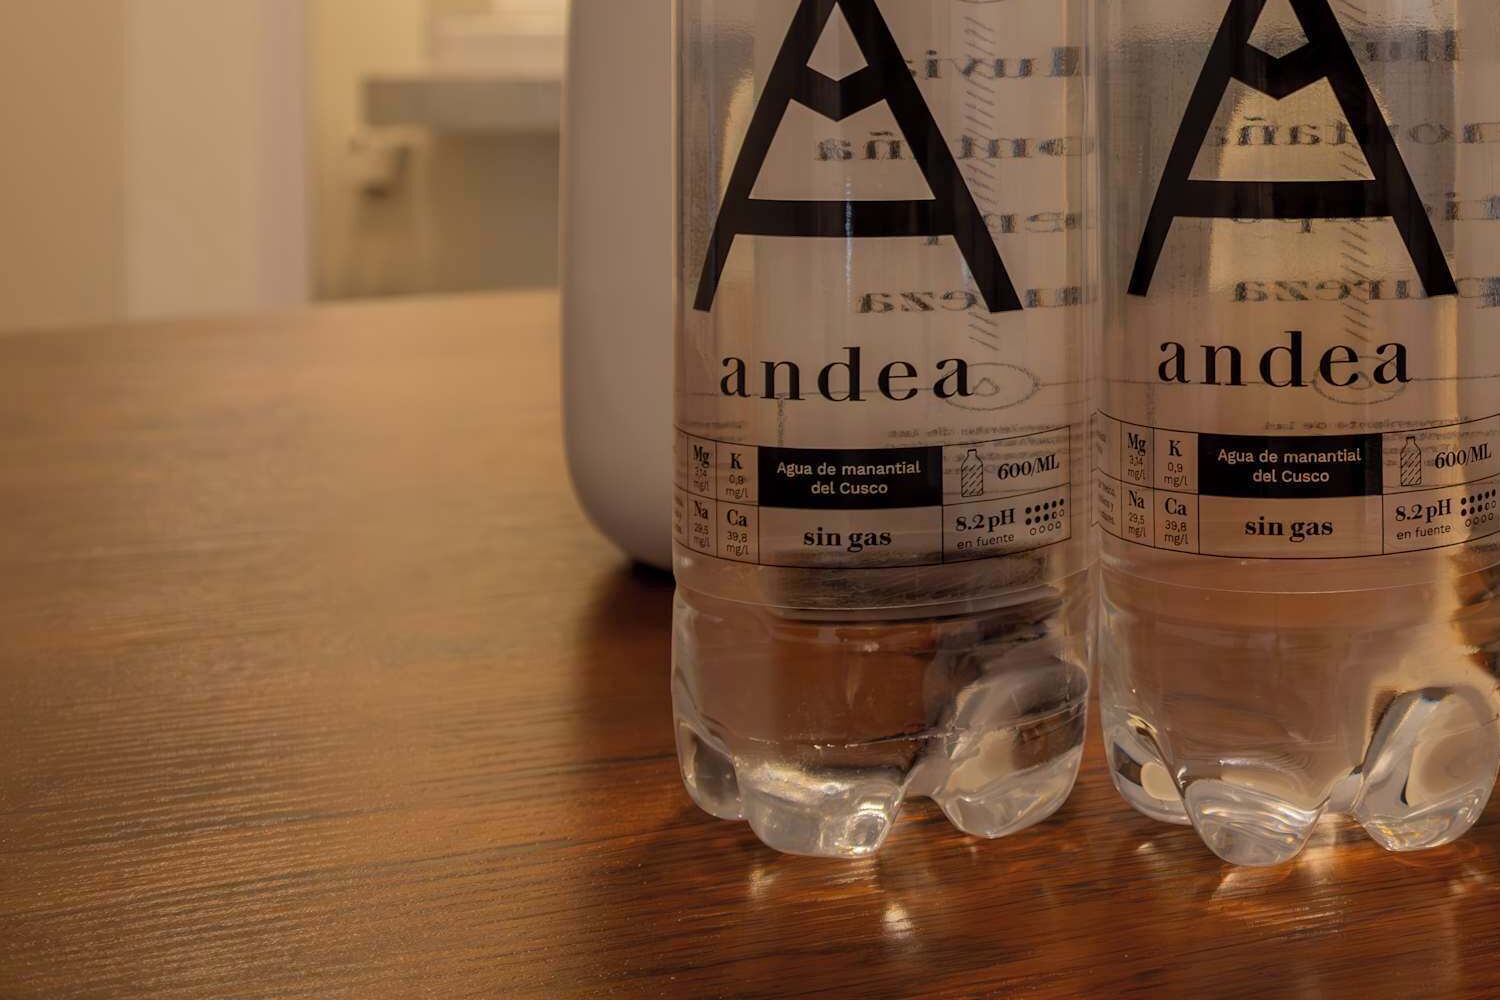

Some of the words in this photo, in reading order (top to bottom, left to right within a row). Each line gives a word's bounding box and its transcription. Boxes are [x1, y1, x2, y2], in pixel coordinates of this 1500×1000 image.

[1158, 330, 1413, 387] andea
[720, 346, 974, 402] andea
[1128, 432, 1146, 456] Mg
[1168, 440, 1182, 457] K
[730, 453, 742, 469] K
[1218, 449, 1254, 464] Agua
[1259, 449, 1278, 463] de
[1284, 448, 1361, 463] manantial
[1434, 443, 1492, 469] 600/ML
[777, 461, 813, 477] Agua
[817, 462, 836, 475] de
[842, 460, 921, 475] manantial
[998, 454, 1059, 480] 600/ML
[1164, 475, 1188, 487] mg/l
[1253, 469, 1277, 482] del
[1282, 470, 1329, 483] Cusco
[726, 487, 748, 499] mg/l
[811, 481, 835, 494] del
[839, 482, 888, 495] Cusco
[1129, 490, 1144, 509] Na
[1164, 497, 1187, 516] Ca
[694, 500, 708, 519] Na
[727, 509, 747, 528] Ca
[1245, 516, 1283, 536] sin
[1289, 521, 1333, 543] gas
[1396, 531, 1411, 540] en
[1416, 525, 1451, 538] fuente
[803, 526, 842, 546] sin
[848, 531, 892, 552] gas
[957, 540, 972, 550] en
[977, 534, 1014, 547] fuente
[1164, 533, 1188, 546] mg/l
[726, 544, 749, 556] mg/l
